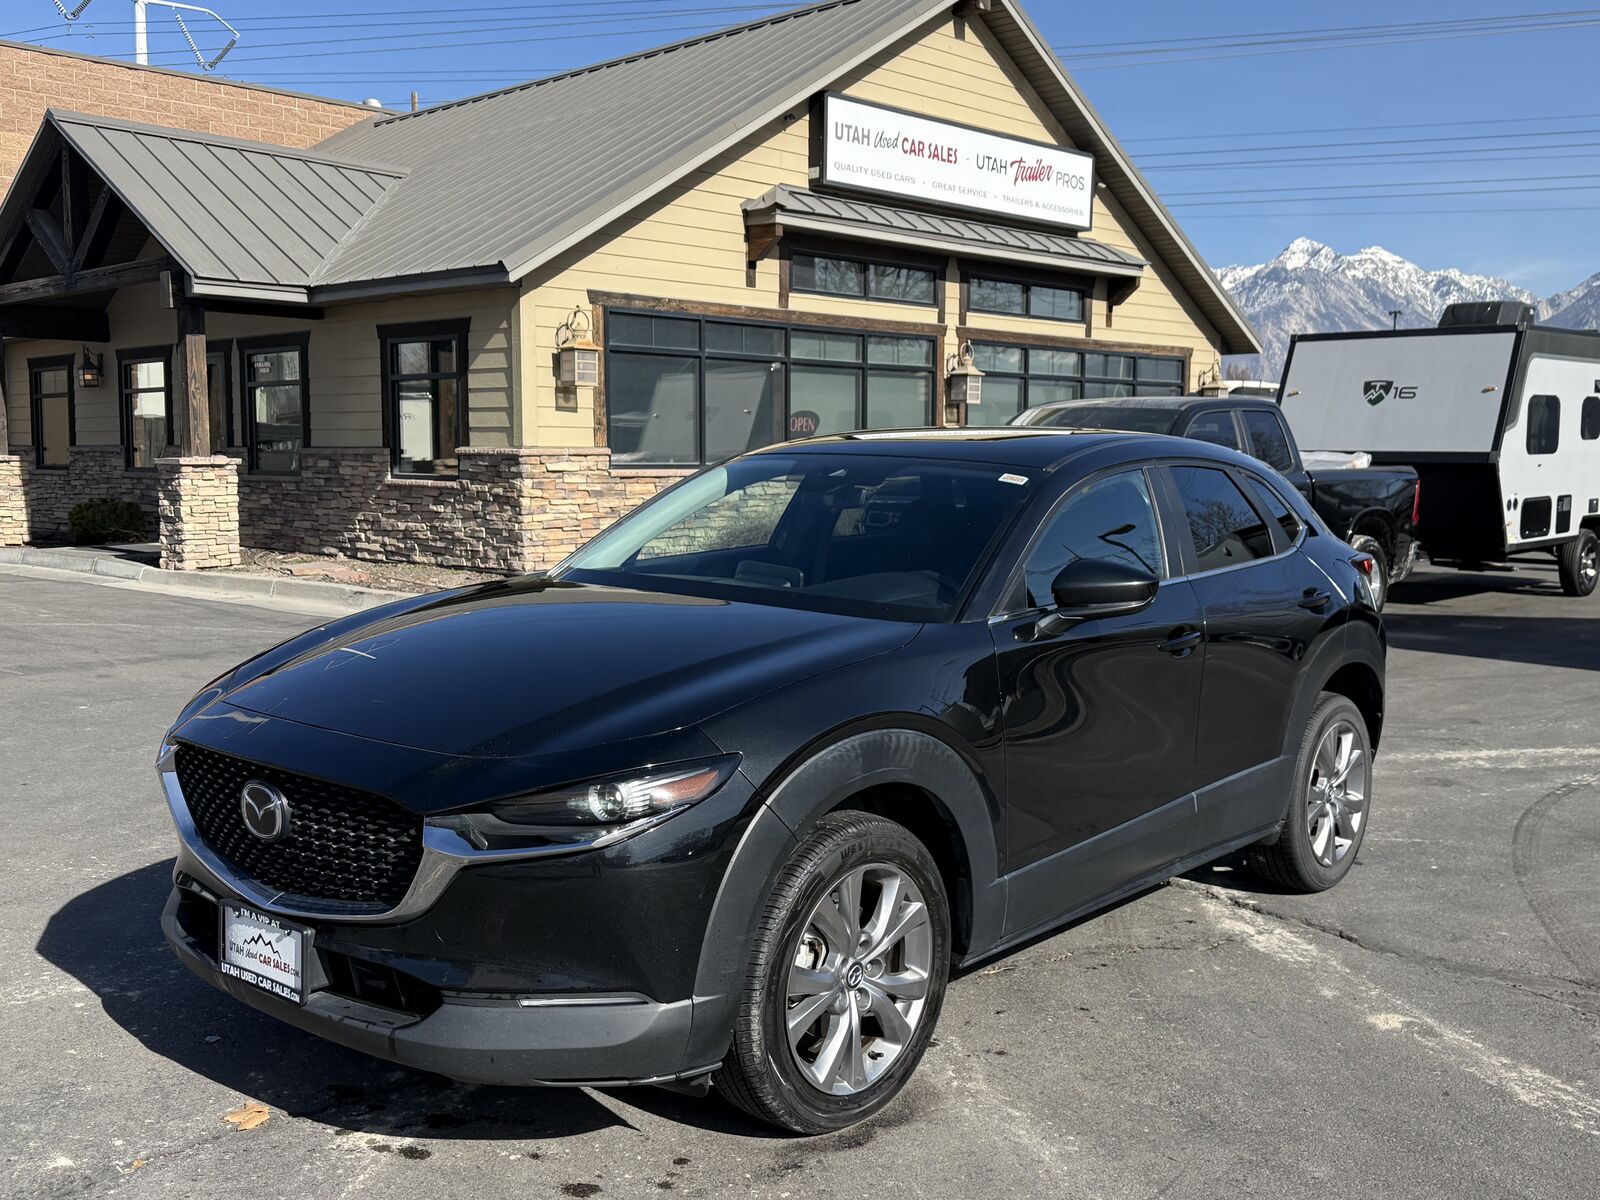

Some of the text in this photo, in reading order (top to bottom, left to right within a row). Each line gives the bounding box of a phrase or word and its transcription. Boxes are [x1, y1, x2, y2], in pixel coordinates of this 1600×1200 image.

[835, 121, 870, 146] UTAH
[873, 130, 900, 149] Used
[901, 137, 925, 158] CAR
[976, 153, 1007, 175] UTAH
[1010, 157, 1054, 187] Trailer
[1055, 171, 1085, 191] PROS
[834, 161, 1084, 217] QUALITY USED CARS GREAT SERVICE TRAILERS & ACCESSORIES
[1393, 386, 1418, 399] 16
[790, 416, 816, 432] OPEN
[251, 912, 257, 921] A
[257, 914, 270, 924] VIP
[271, 919, 280, 929] AT
[229, 940, 244, 956] UTAH
[245, 947, 259, 960] Used
[259, 953, 272, 967] CAR
[221, 962, 240, 978] UTAH
[240, 969, 257, 984] USED
[258, 976, 272, 991] CAR
